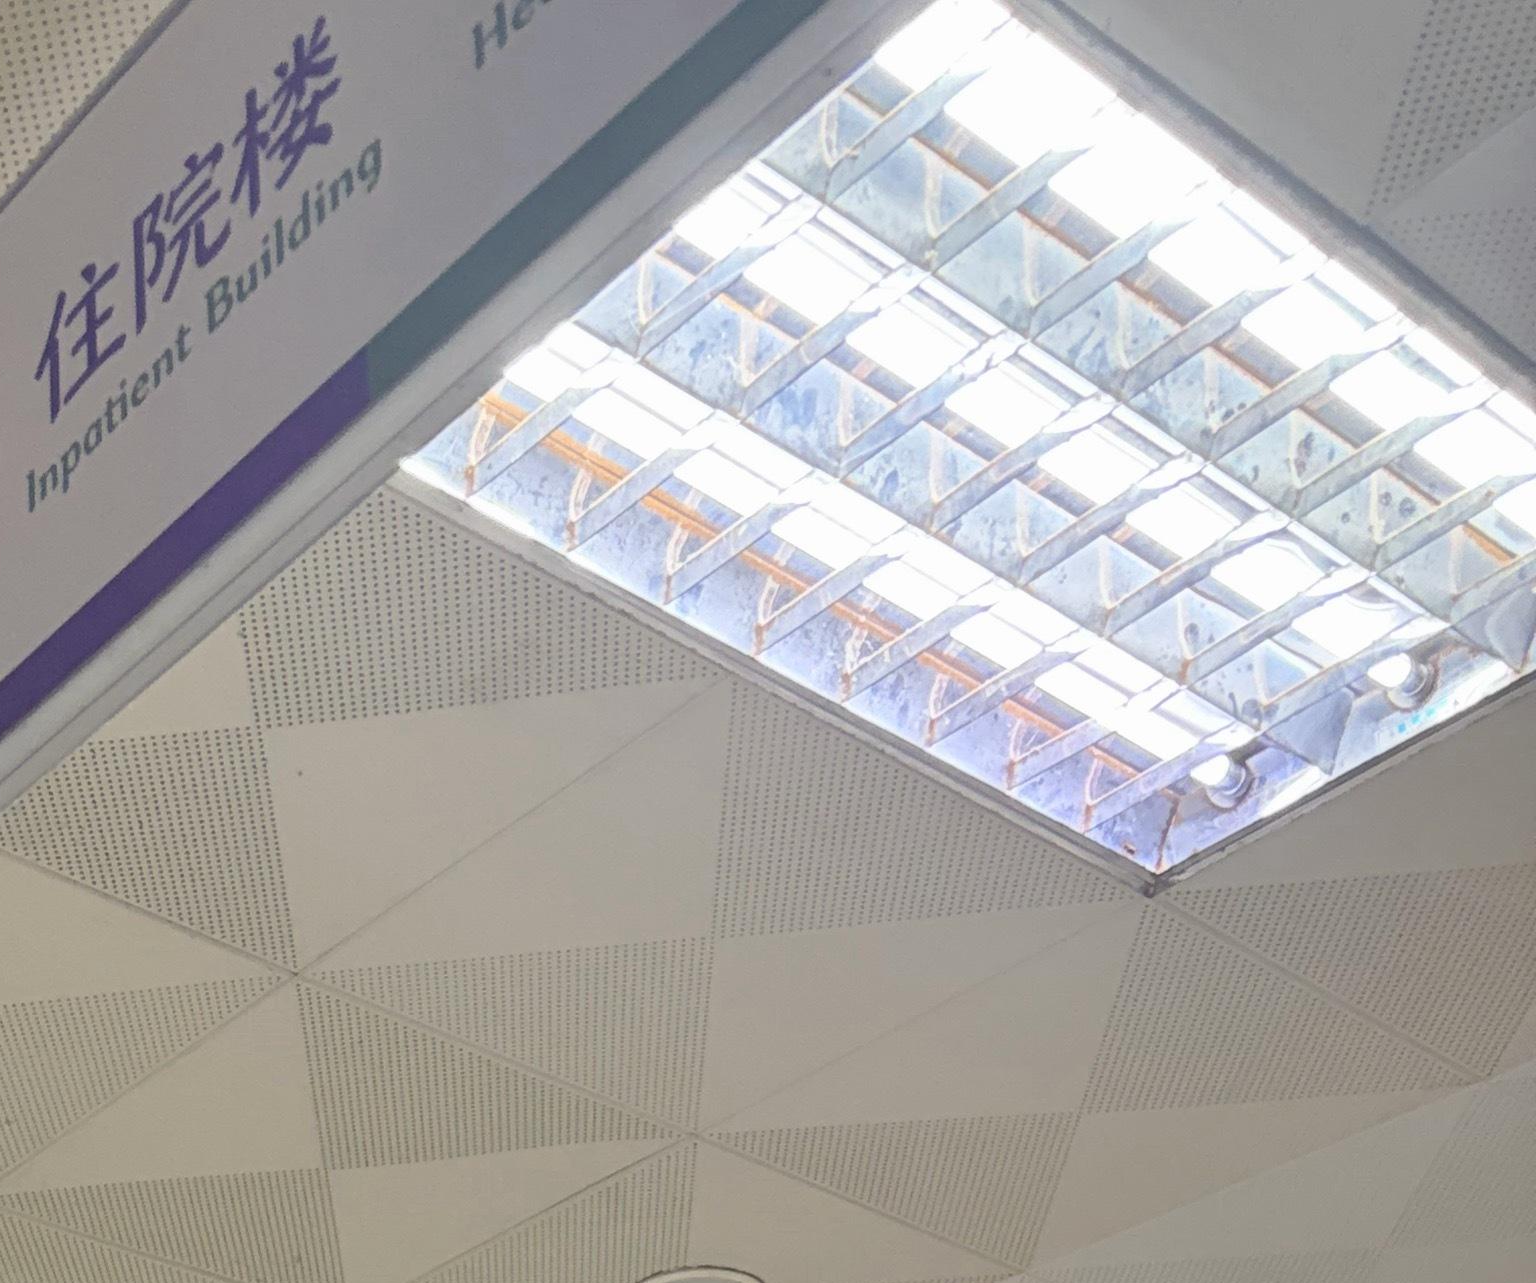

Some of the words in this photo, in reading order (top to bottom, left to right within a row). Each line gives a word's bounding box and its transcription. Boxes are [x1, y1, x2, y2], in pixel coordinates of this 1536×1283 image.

[34, 15, 341, 424] 住院楼
[472, 0, 551, 70] He
[26, 323, 192, 512] Inpatient
[205, 138, 383, 333] Building
